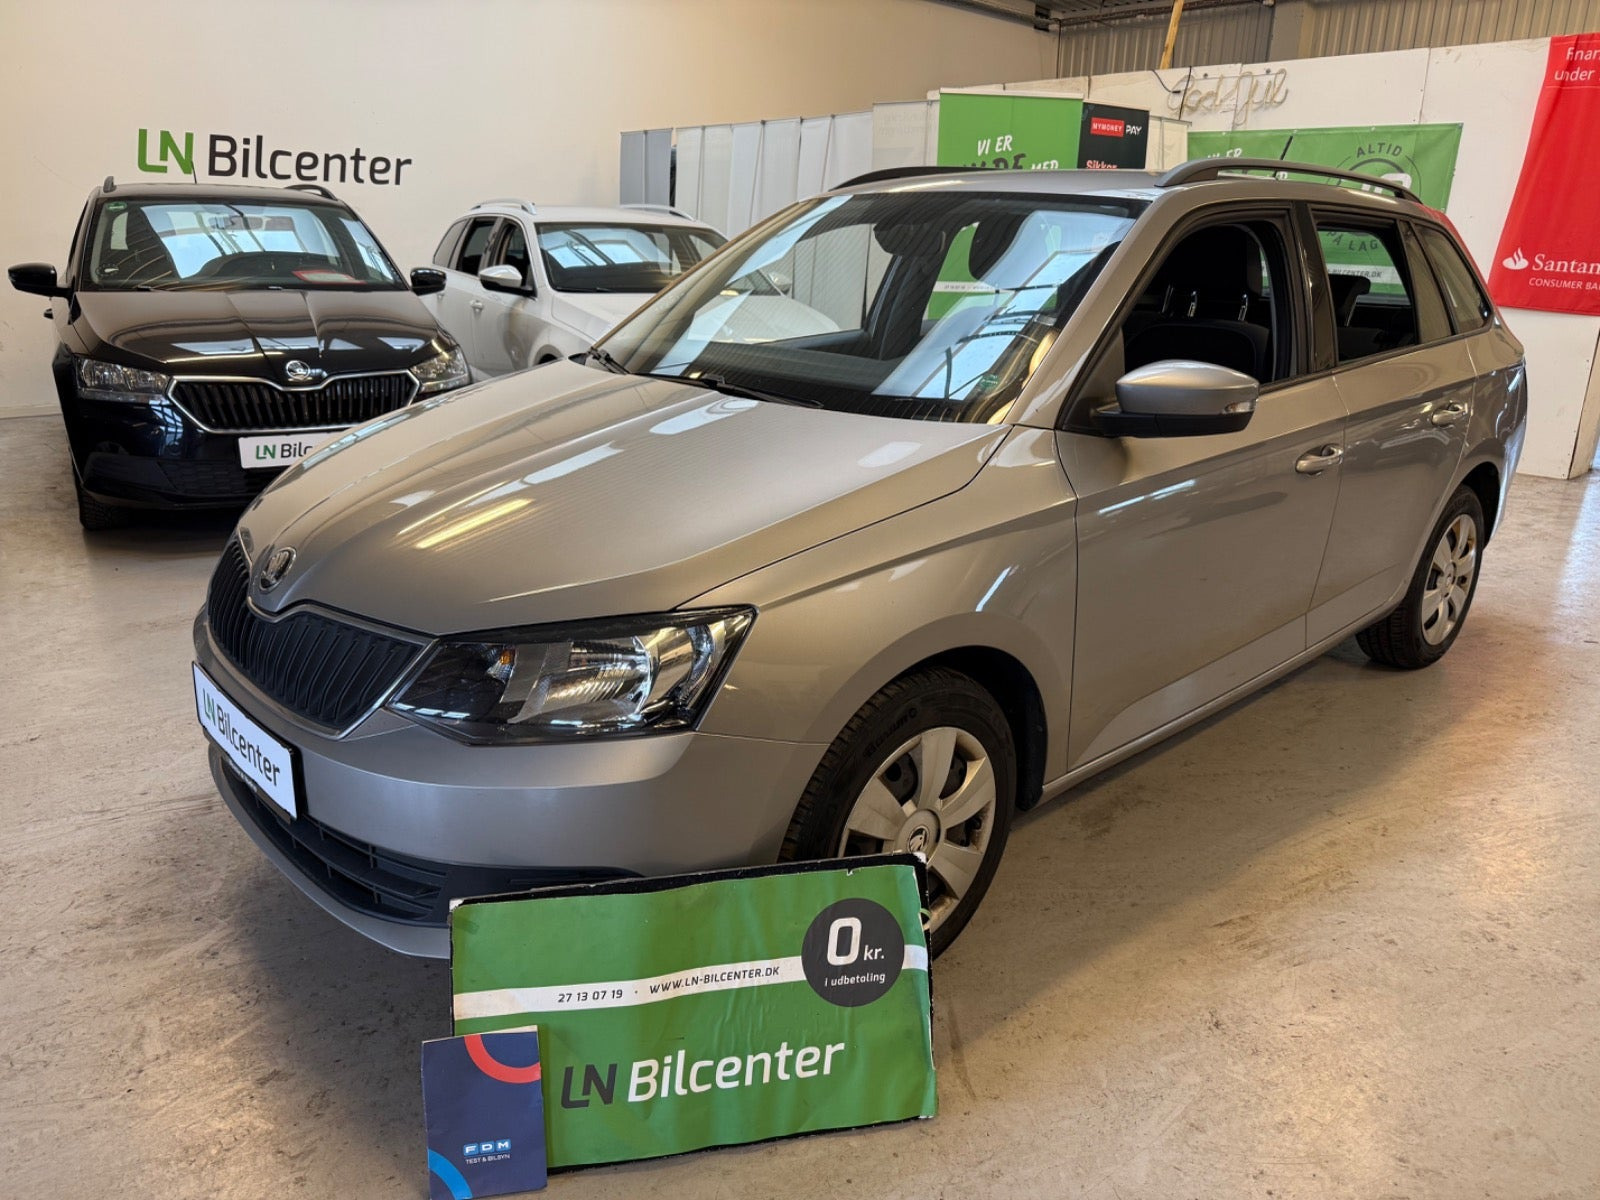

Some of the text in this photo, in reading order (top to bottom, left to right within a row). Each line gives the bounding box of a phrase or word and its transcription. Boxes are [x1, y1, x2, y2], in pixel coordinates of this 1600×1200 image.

[1554, 66, 1596, 81] under
[1125, 125, 1142, 135] PAY
[977, 134, 1012, 156] VI ER
[1356, 142, 1402, 158] ALTID
[137, 128, 412, 185] LN Bilcenter
[1528, 277, 1583, 289] CONSUMER
[255, 444, 276, 460] LN
[203, 689, 216, 727] LN
[216, 703, 280, 787] Bilcenter
[863, 944, 885, 960] kr.
[558, 966, 781, 1003] 27 13 07 19 WWW.LN-BILCENTER.DK
[830, 972, 886, 987] udbetaling
[561, 1042, 845, 1109] LN Bilcenter
[465, 1141, 509, 1154] FDM
